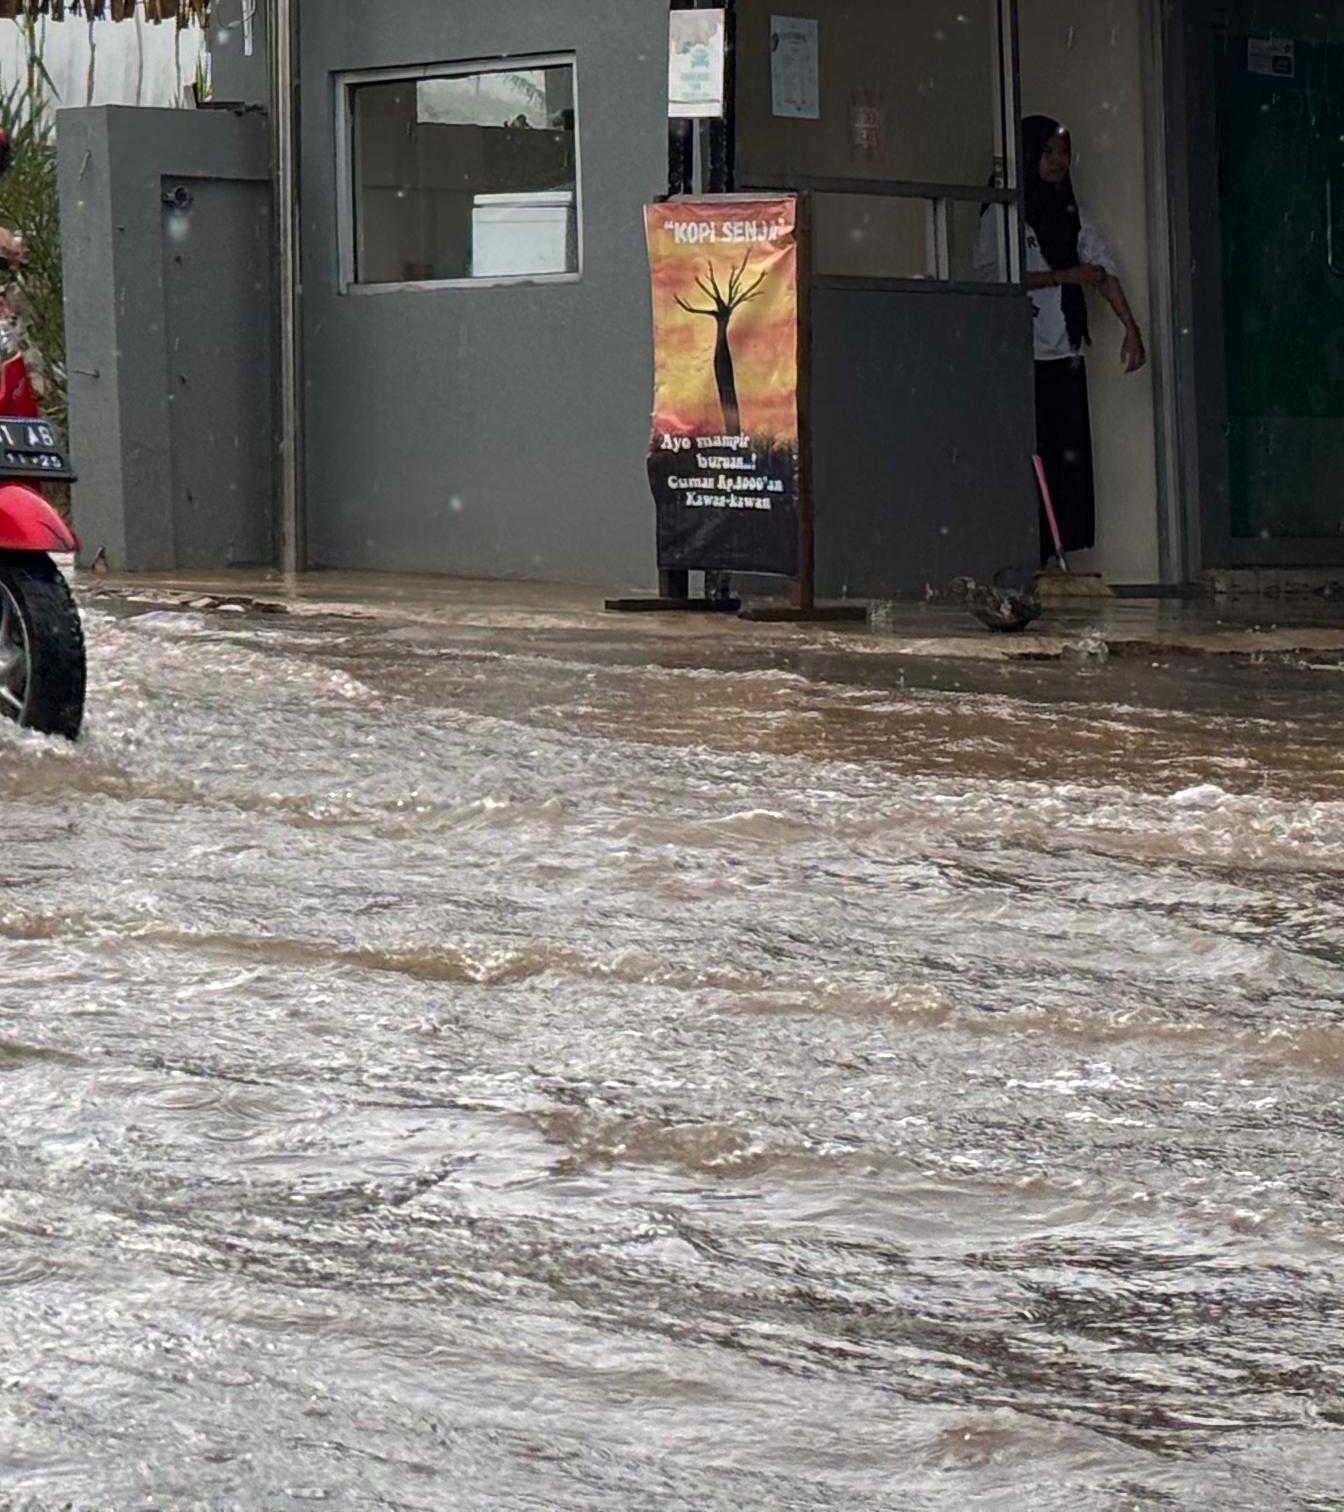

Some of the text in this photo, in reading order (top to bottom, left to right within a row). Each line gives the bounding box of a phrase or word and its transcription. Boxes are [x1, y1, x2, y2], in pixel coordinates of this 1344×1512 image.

[26, 425, 54, 446] AB
[661, 432, 750, 453] Ayo mampir
[667, 475, 715, 489] Cuman
